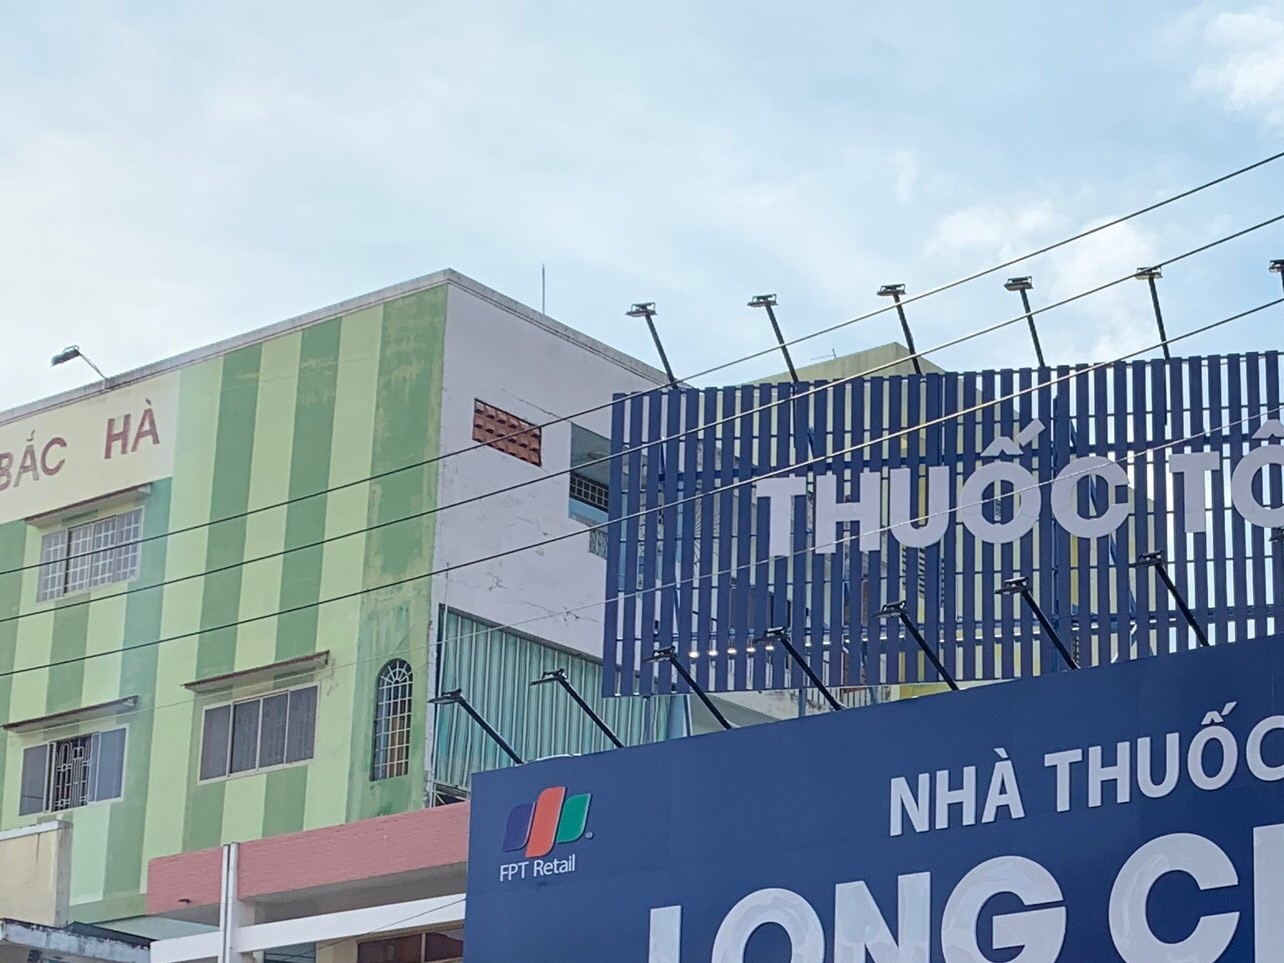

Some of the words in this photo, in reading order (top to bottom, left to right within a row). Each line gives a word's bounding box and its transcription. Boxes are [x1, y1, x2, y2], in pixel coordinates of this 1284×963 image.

[0, 429, 67, 491] BẮC
[104, 398, 160, 459] HÀ
[755, 418, 1131, 557] THUỐC
[889, 748, 1026, 836] NHÀ
[500, 861, 529, 882] FPT
[533, 854, 576, 877] Retail
